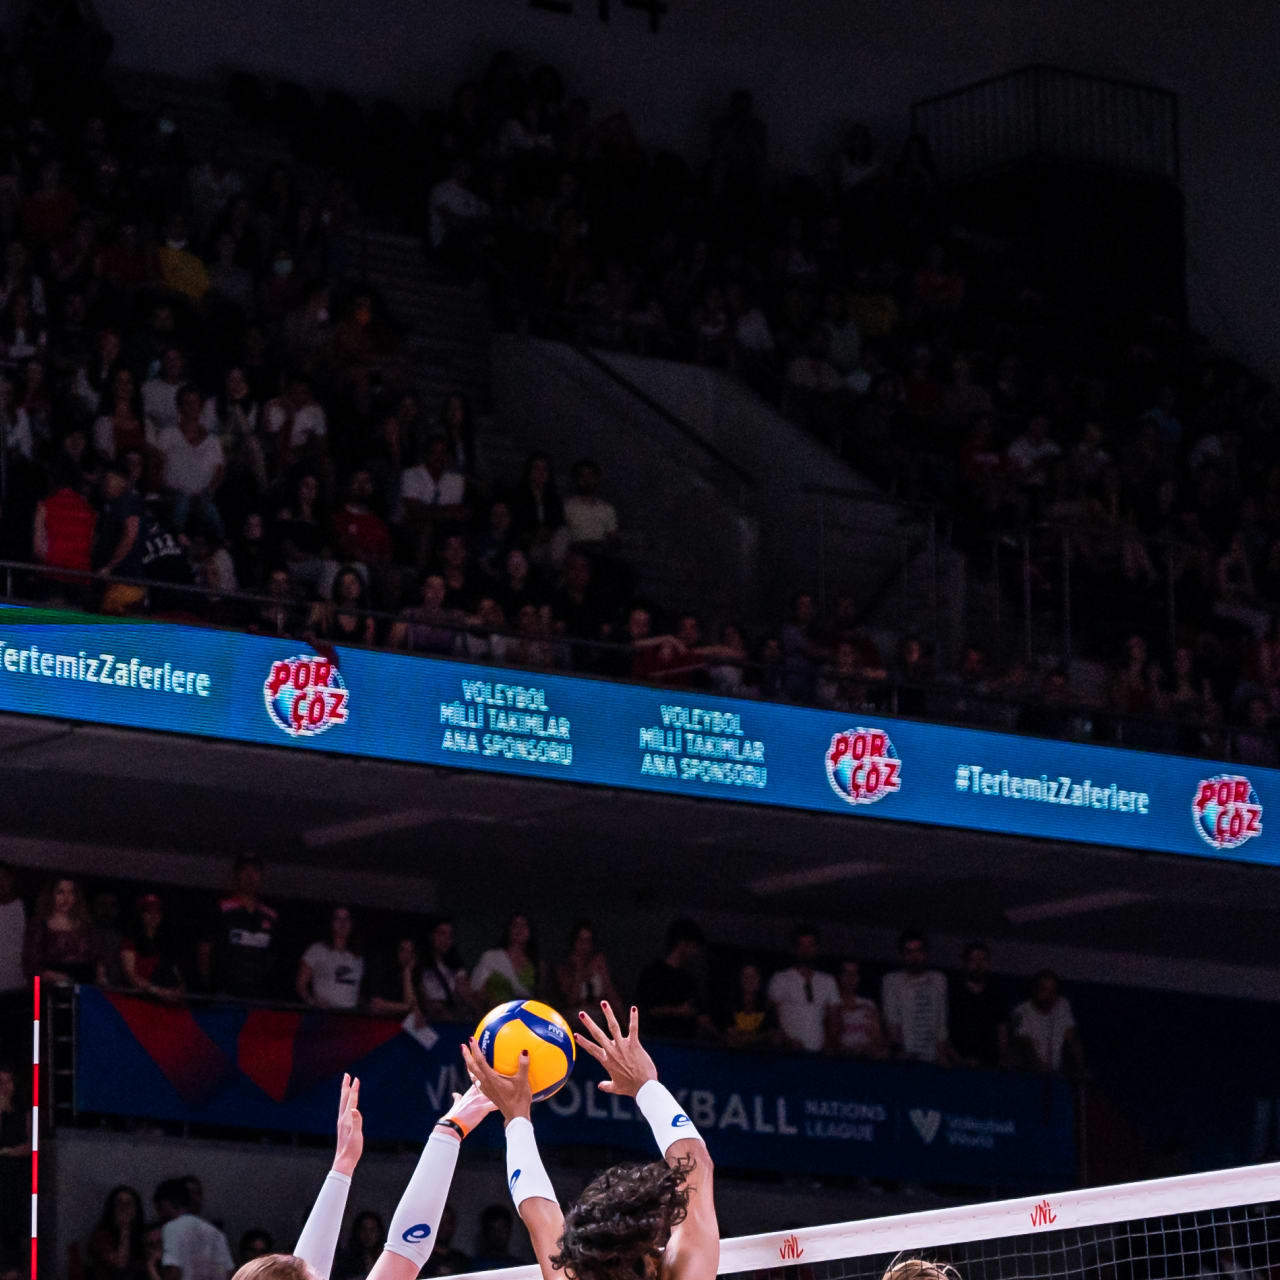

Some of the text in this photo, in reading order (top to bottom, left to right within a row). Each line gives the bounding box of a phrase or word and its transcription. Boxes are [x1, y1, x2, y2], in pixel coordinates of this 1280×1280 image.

[269, 661, 332, 700] POR
[462, 680, 549, 711] VOLEYBOL
[488, 708, 569, 739] TAKIMLAR
[442, 730, 480, 754] ANA
[831, 734, 887, 766] POR
[956, 764, 1150, 814] #TertemizZaferlere
[1197, 781, 1250, 811] POR
[1031, 1200, 1056, 1226] VNL
[780, 1235, 803, 1259] VNL
